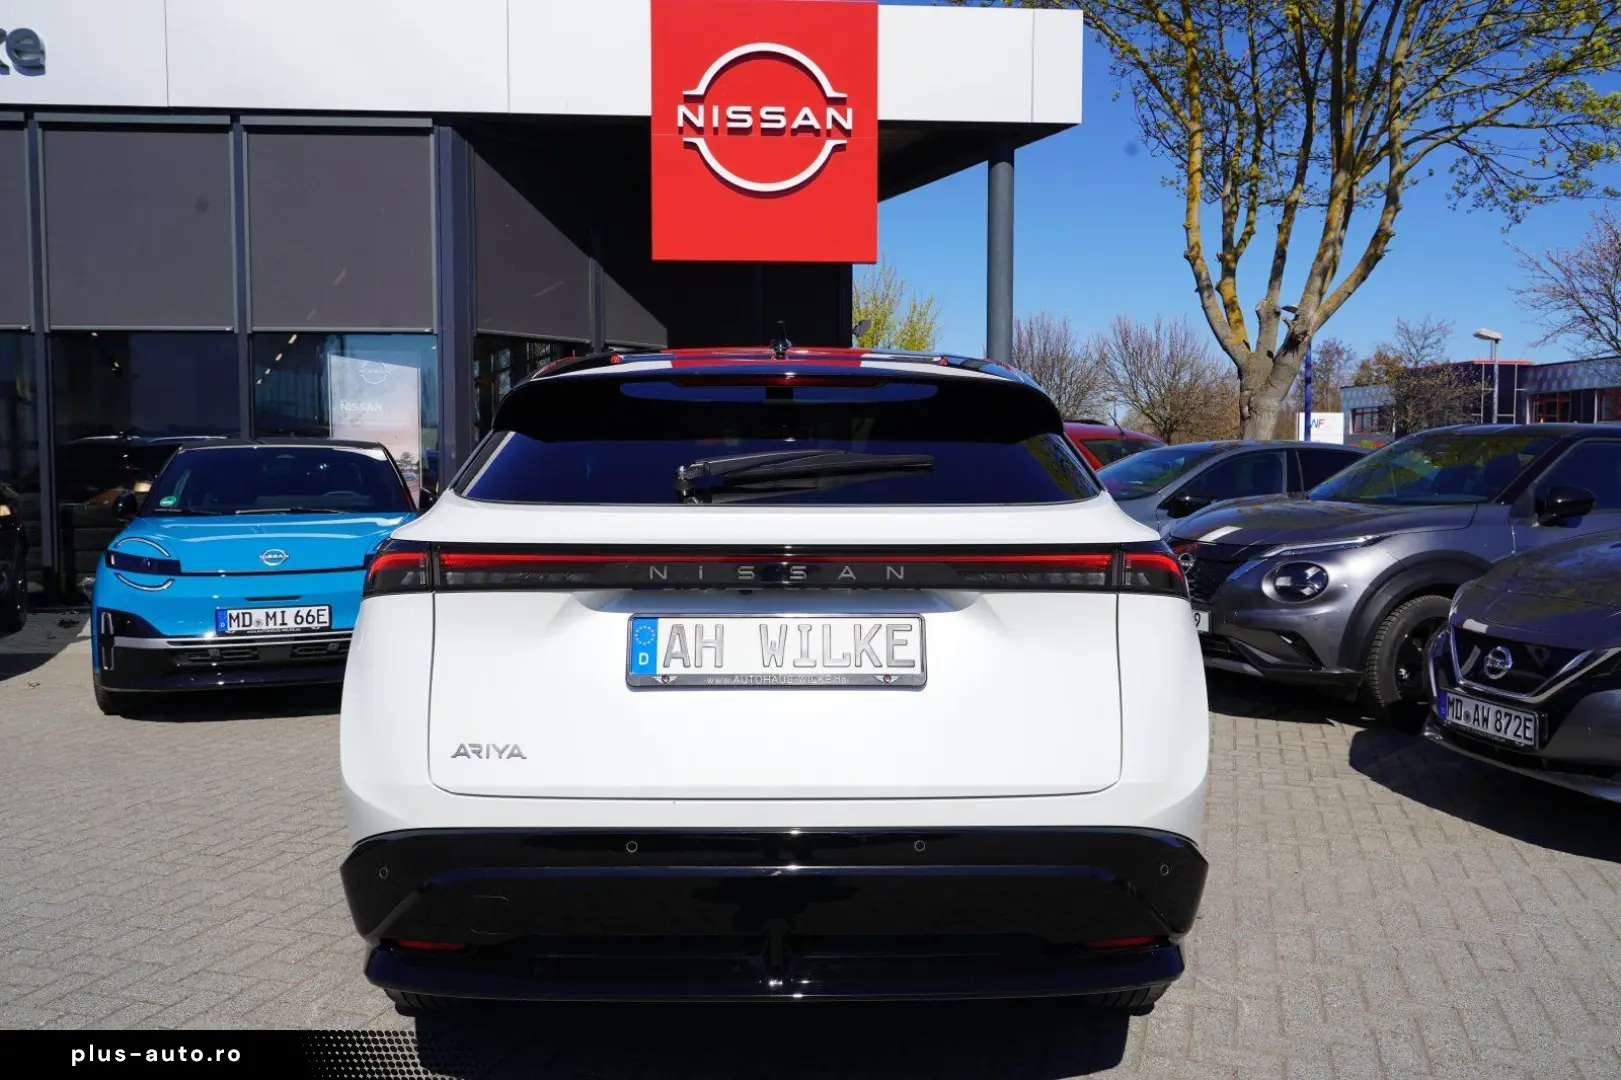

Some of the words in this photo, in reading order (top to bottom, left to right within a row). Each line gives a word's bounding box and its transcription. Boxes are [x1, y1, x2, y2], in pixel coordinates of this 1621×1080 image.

[677, 105, 853, 131] NISSAN
[340, 402, 383, 412] NISSAN
[649, 566, 905, 580] NISSAN
[228, 611, 253, 629] MD
[265, 610, 288, 627] MI
[294, 608, 328, 626] 66E
[638, 653, 649, 666] D
[662, 624, 724, 669] AH
[759, 624, 916, 669] WILKE
[1446, 695, 1463, 721] MD
[1472, 703, 1490, 730] AW
[1494, 709, 1534, 742] 872E
[450, 743, 528, 760] ARIYA
